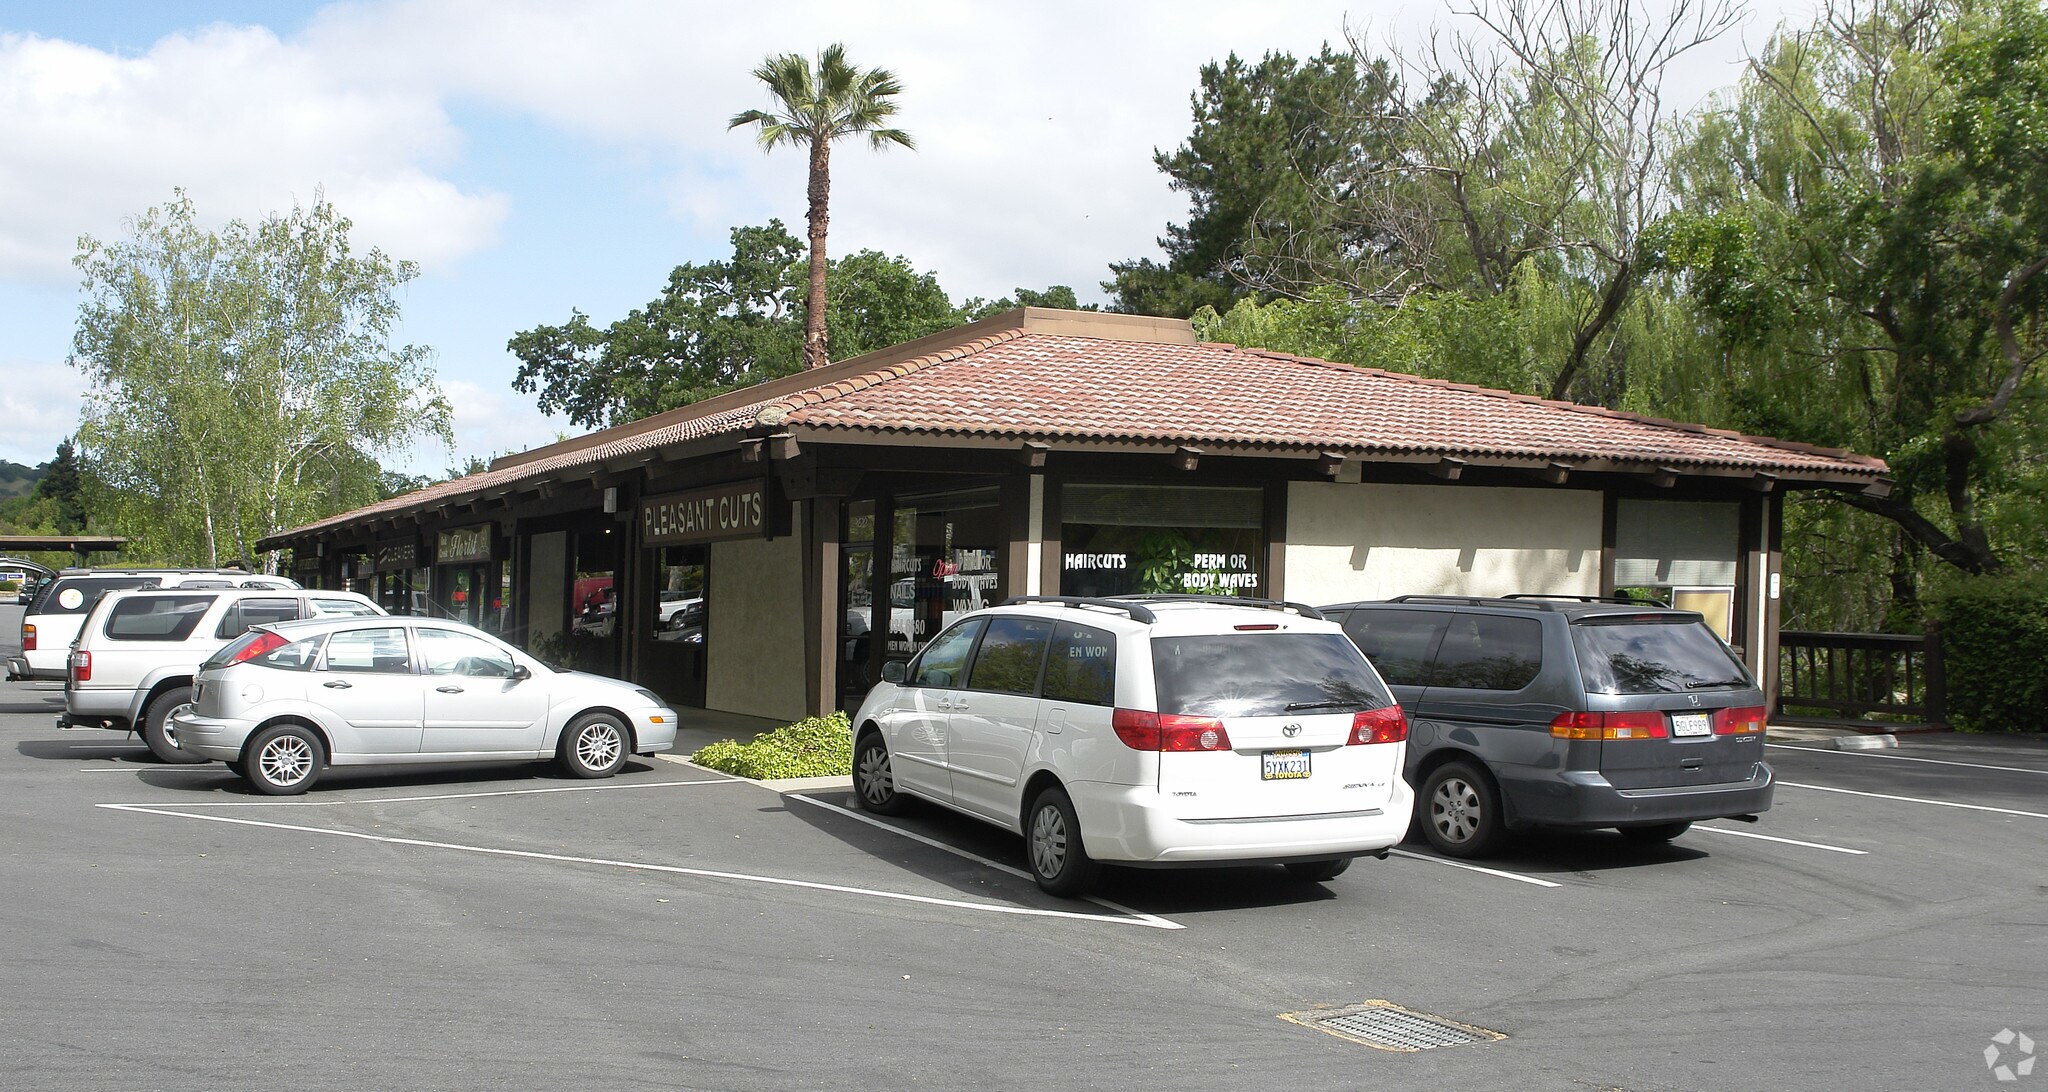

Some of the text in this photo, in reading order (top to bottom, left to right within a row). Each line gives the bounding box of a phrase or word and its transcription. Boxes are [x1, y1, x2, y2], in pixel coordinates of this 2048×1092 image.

[645, 492, 761, 536] PLEASANT CUTS
[449, 534, 478, 558] Florist
[890, 557, 922, 574] HAIRCUTS
[932, 558, 959, 581] Open
[980, 554, 992, 571] OR
[1065, 553, 1127, 570] HAIRCUTS
[1194, 553, 1247, 570] PERM OR
[952, 573, 998, 591] BODY WAVES
[1183, 573, 1258, 589] BODY WAVES
[890, 583, 916, 600] NAILS
[953, 598, 990, 614] WAXING
[887, 640, 899, 651] MEN
[898, 640, 918, 652] WOMEN
[1068, 646, 1082, 658] EN
[1265, 760, 1307, 774] 5YXK231
